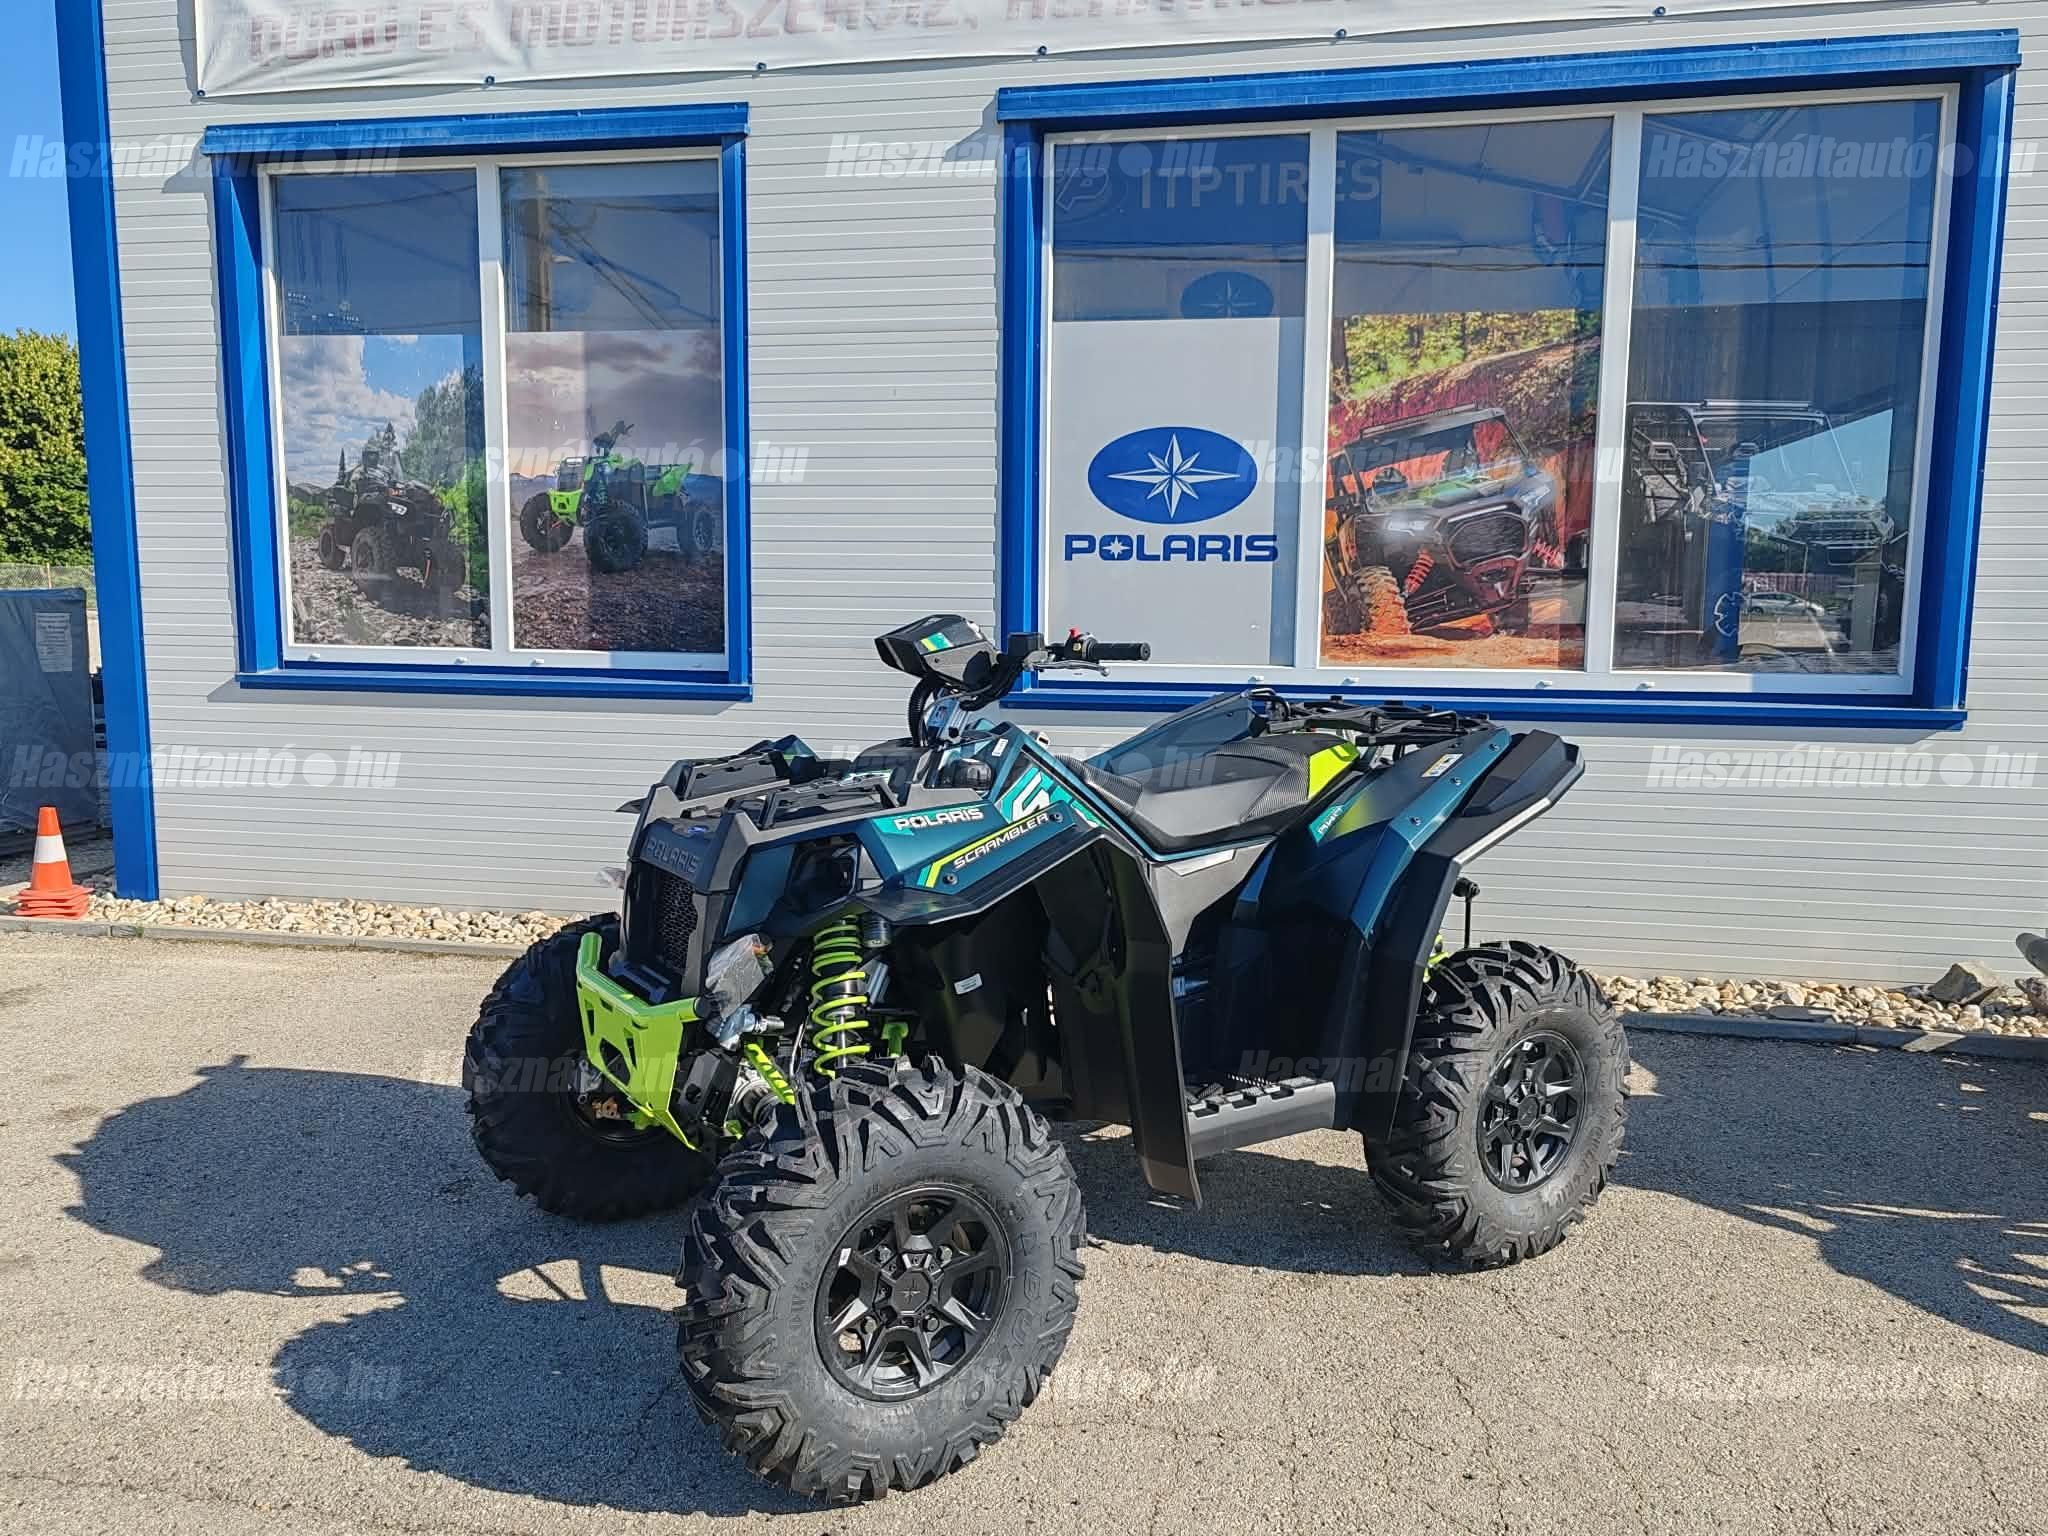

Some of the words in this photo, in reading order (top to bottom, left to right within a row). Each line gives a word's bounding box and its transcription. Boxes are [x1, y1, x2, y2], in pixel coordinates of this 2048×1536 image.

[1064, 534, 1279, 562] POLARIS
[894, 806, 984, 831] POLARIS
[645, 837, 699, 873] POLARIS
[952, 812, 1049, 869] SCRAMBLER
